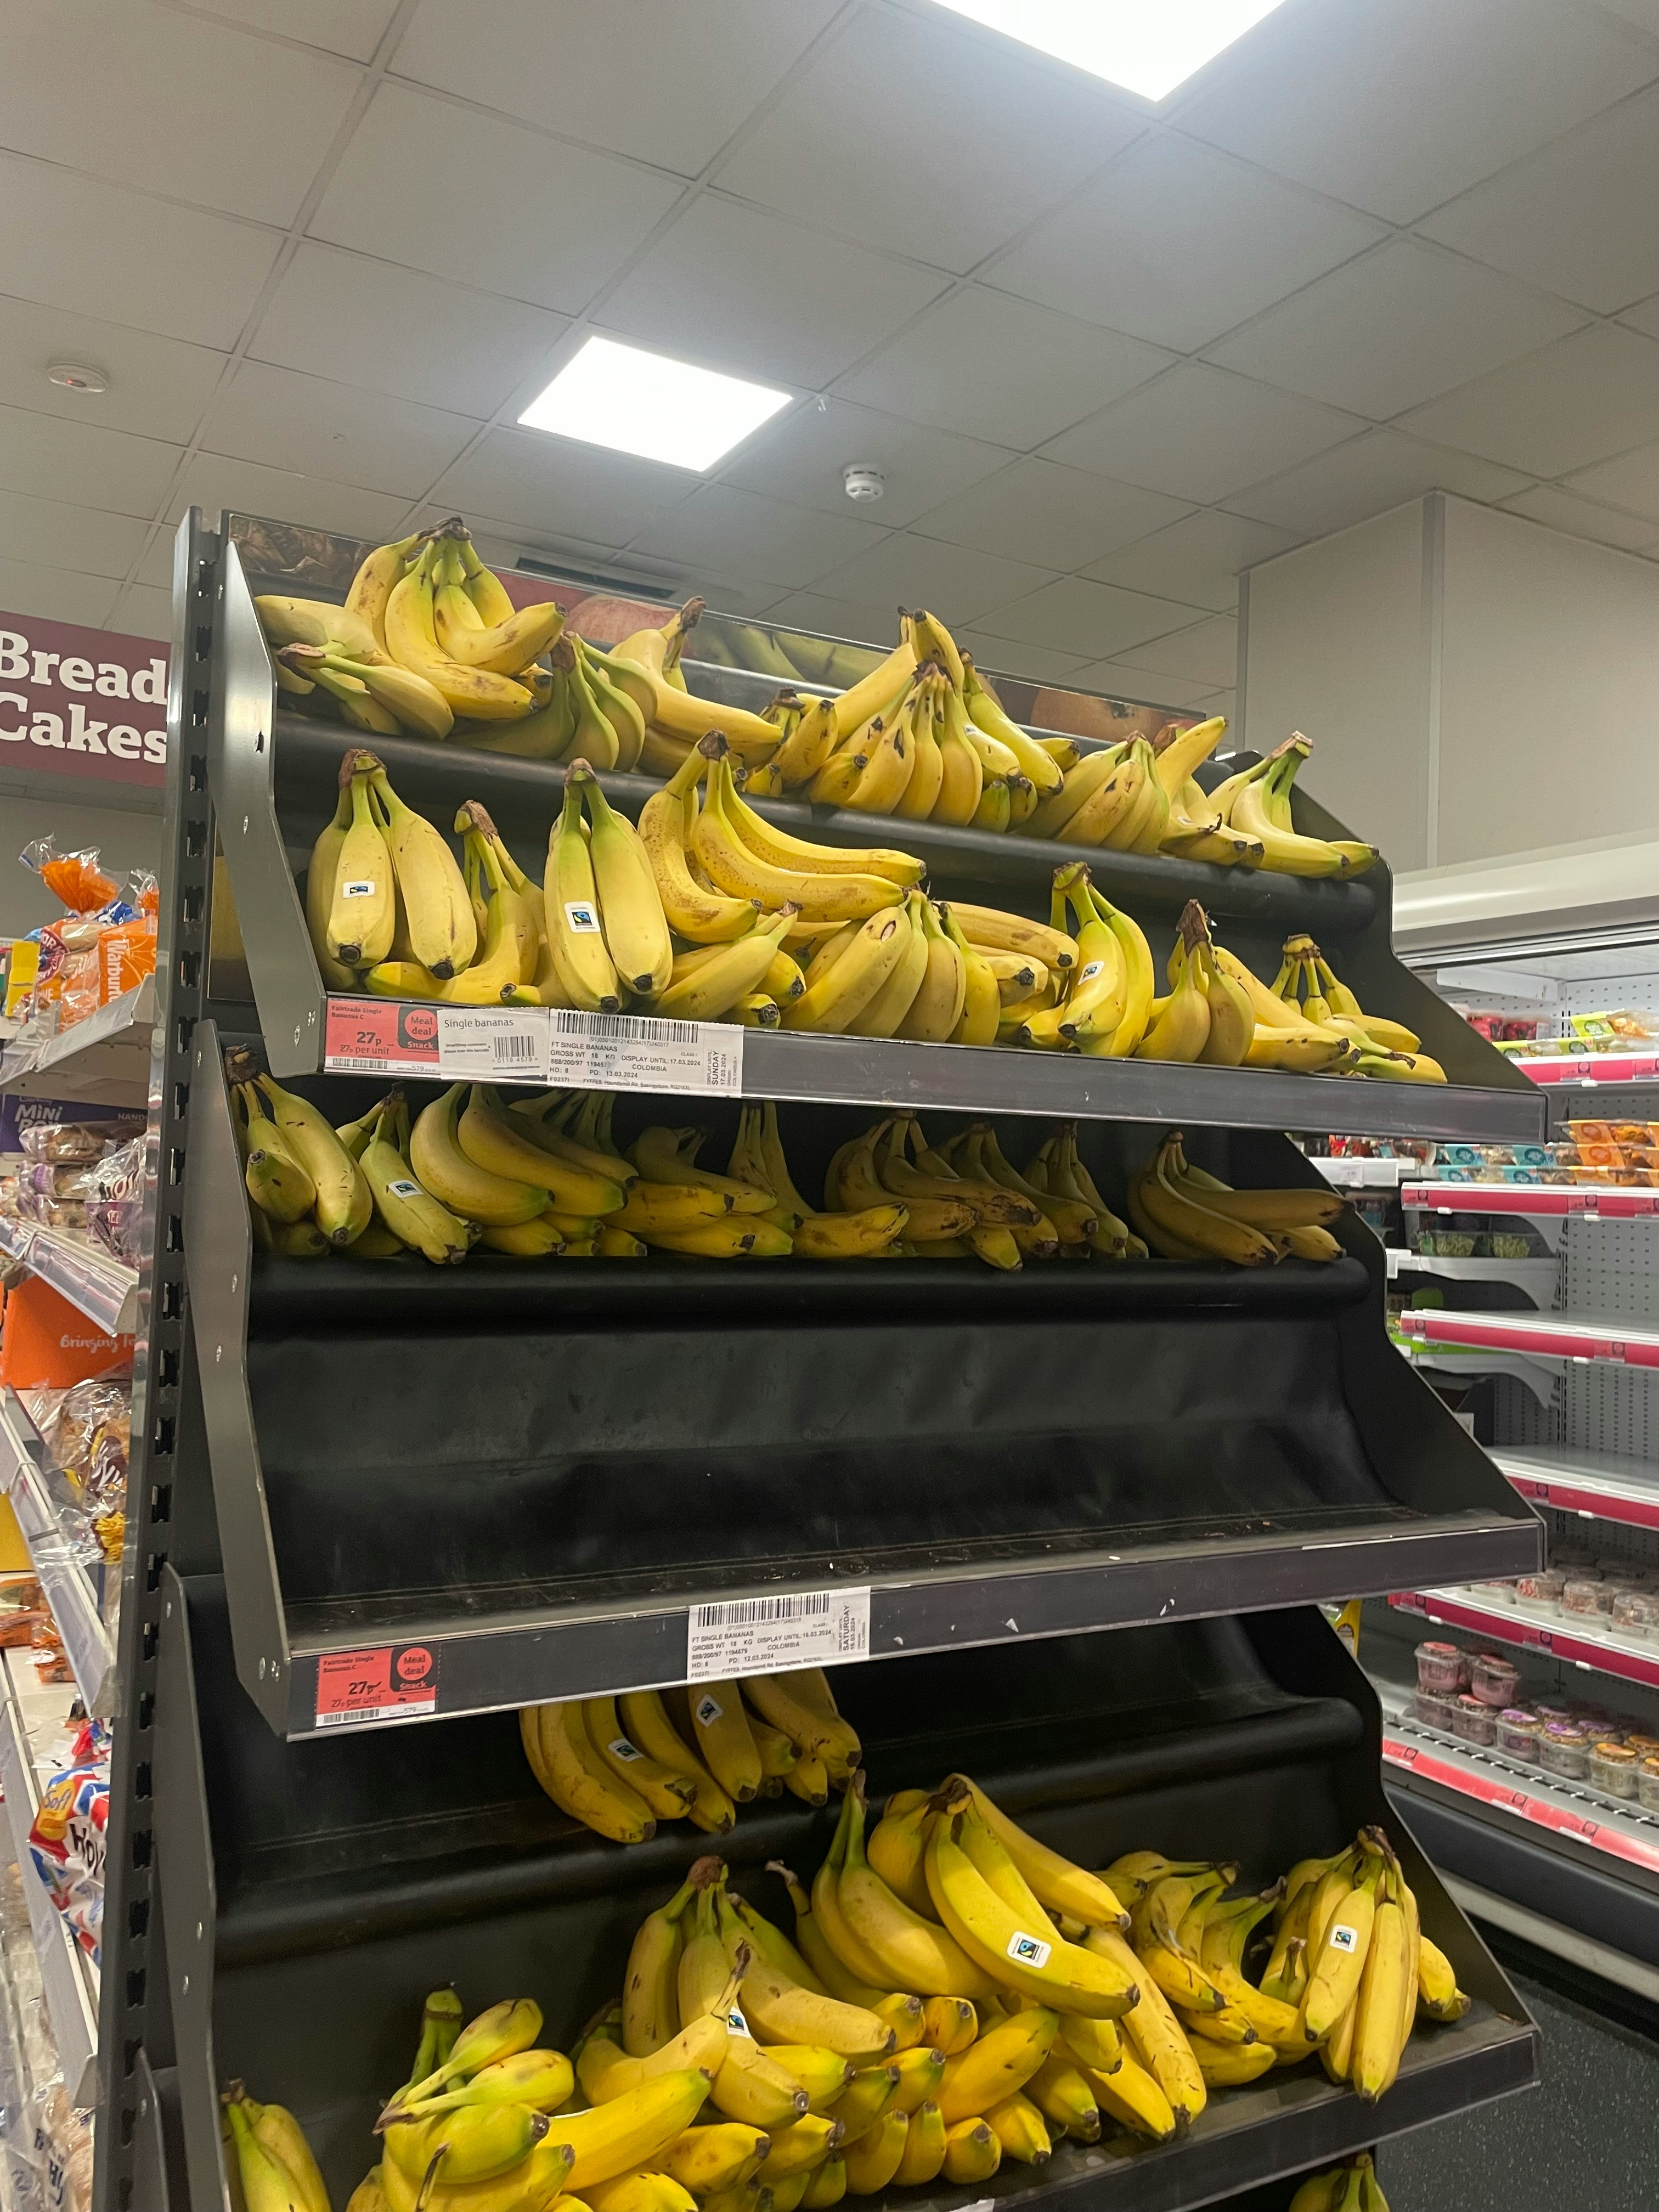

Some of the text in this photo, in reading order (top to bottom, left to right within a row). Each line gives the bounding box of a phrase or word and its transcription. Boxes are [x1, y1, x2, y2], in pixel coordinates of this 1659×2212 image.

[0, 630, 167, 705] Bread
[0, 692, 167, 764] Cakes
[411, 1017, 433, 1025] Meal
[444, 1018, 514, 1030] Single bananas
[412, 1027, 431, 1036] deal
[357, 1031, 382, 1046] 27p
[407, 1041, 434, 1049] Snack
[586, 1044, 618, 1052] BANANAS
[372, 1047, 390, 1055] unit
[632, 1064, 667, 1072] COLOMBIA
[701, 1634, 723, 1642] SINGLE
[724, 1630, 754, 1639] BANANAS
[757, 1635, 782, 1644] DISPLAY
[767, 1641, 800, 1651] COLOMBIA
[403, 1655, 426, 1664] Meal
[404, 1666, 425, 1675] deal
[399, 1680, 427, 1691] Snack
[346, 1697, 361, 1708] per
[363, 1694, 382, 1704] unit
